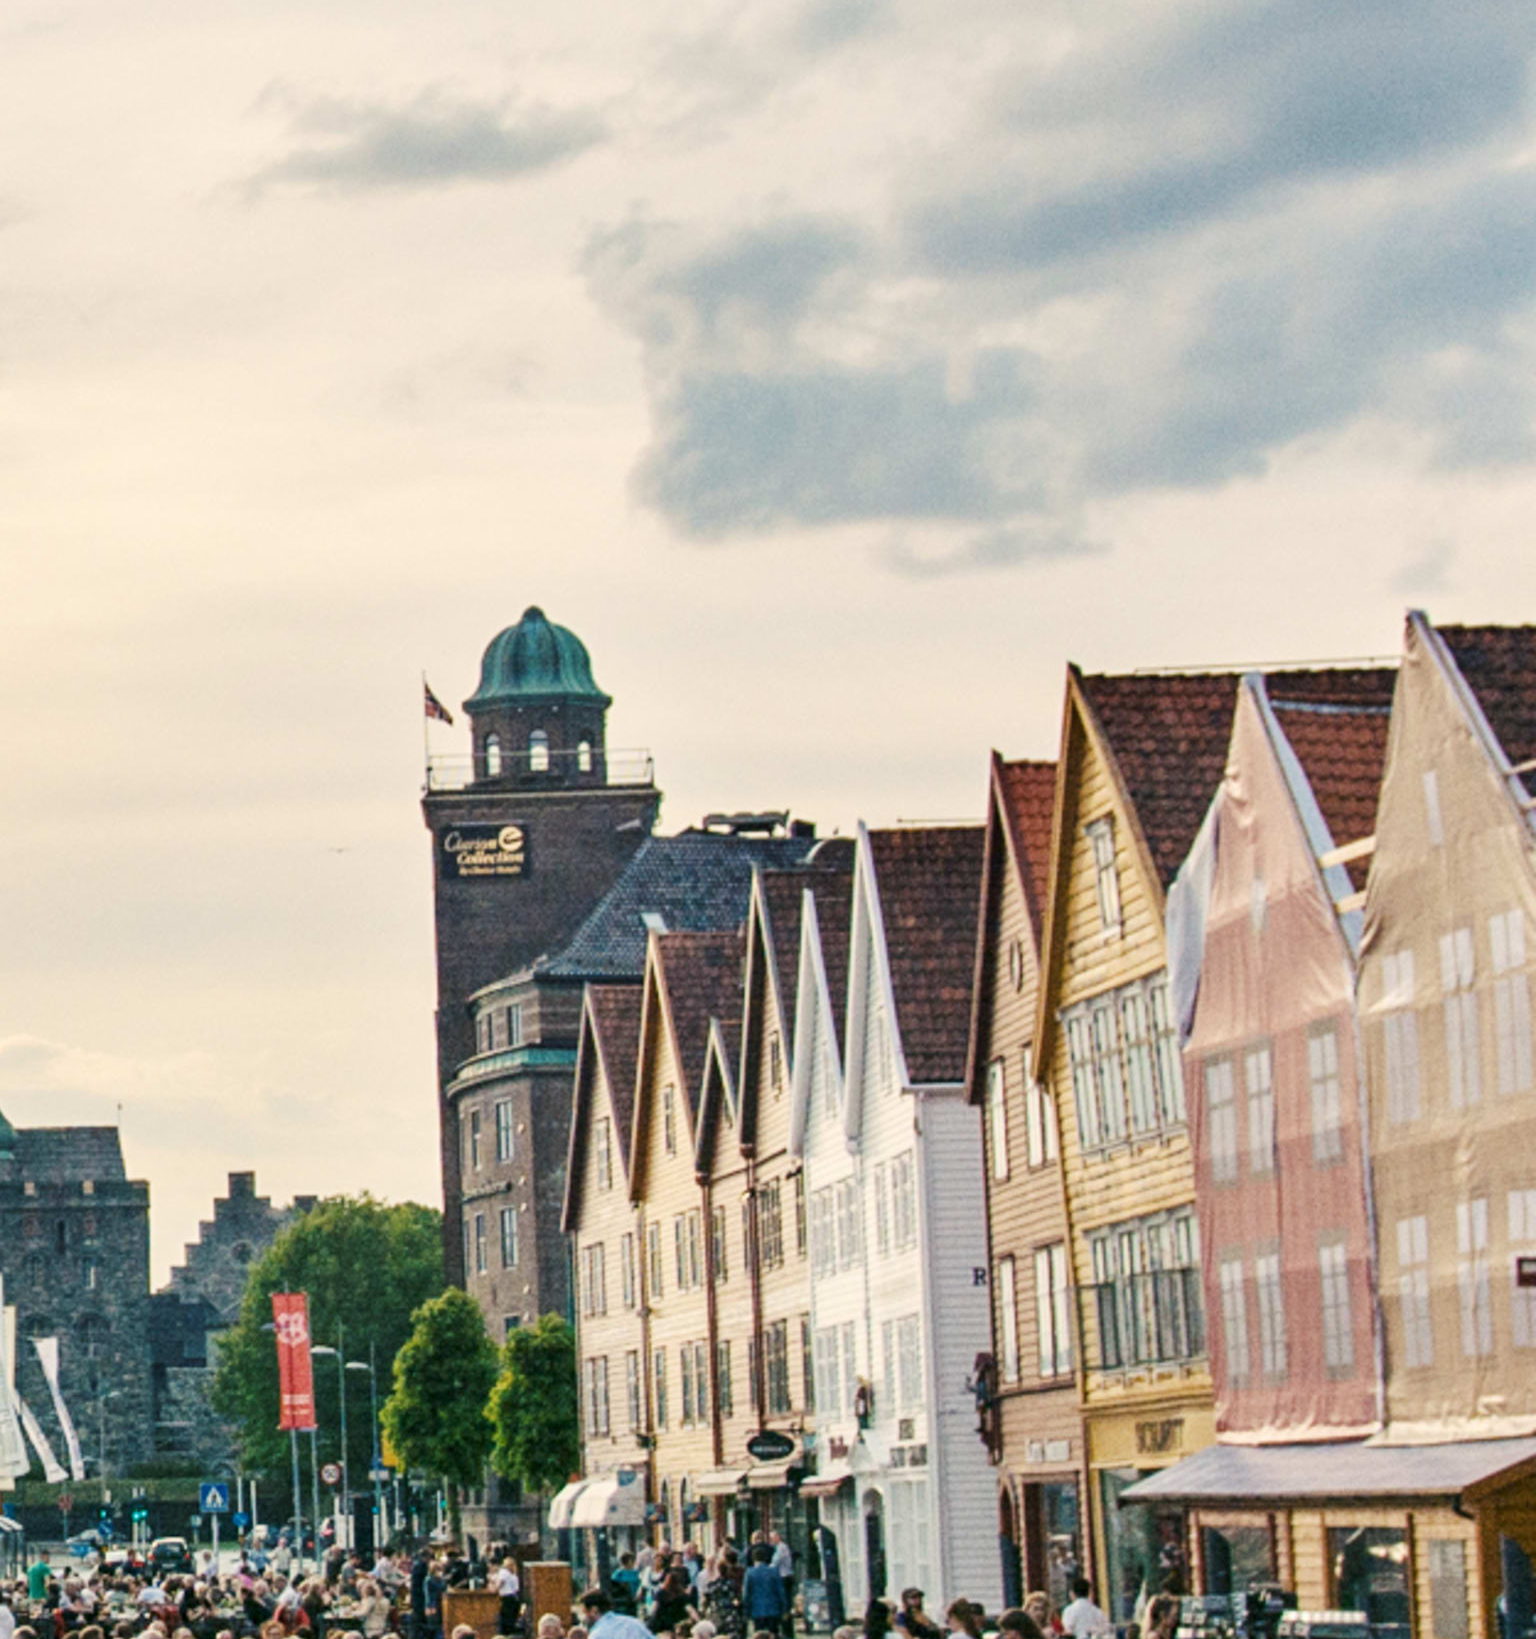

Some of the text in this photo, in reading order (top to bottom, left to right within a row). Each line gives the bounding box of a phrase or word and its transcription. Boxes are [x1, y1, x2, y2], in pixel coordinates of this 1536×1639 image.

[444, 831, 497, 852] Clarion
[456, 850, 525, 865] Collection
[973, 1266, 987, 1287] R
